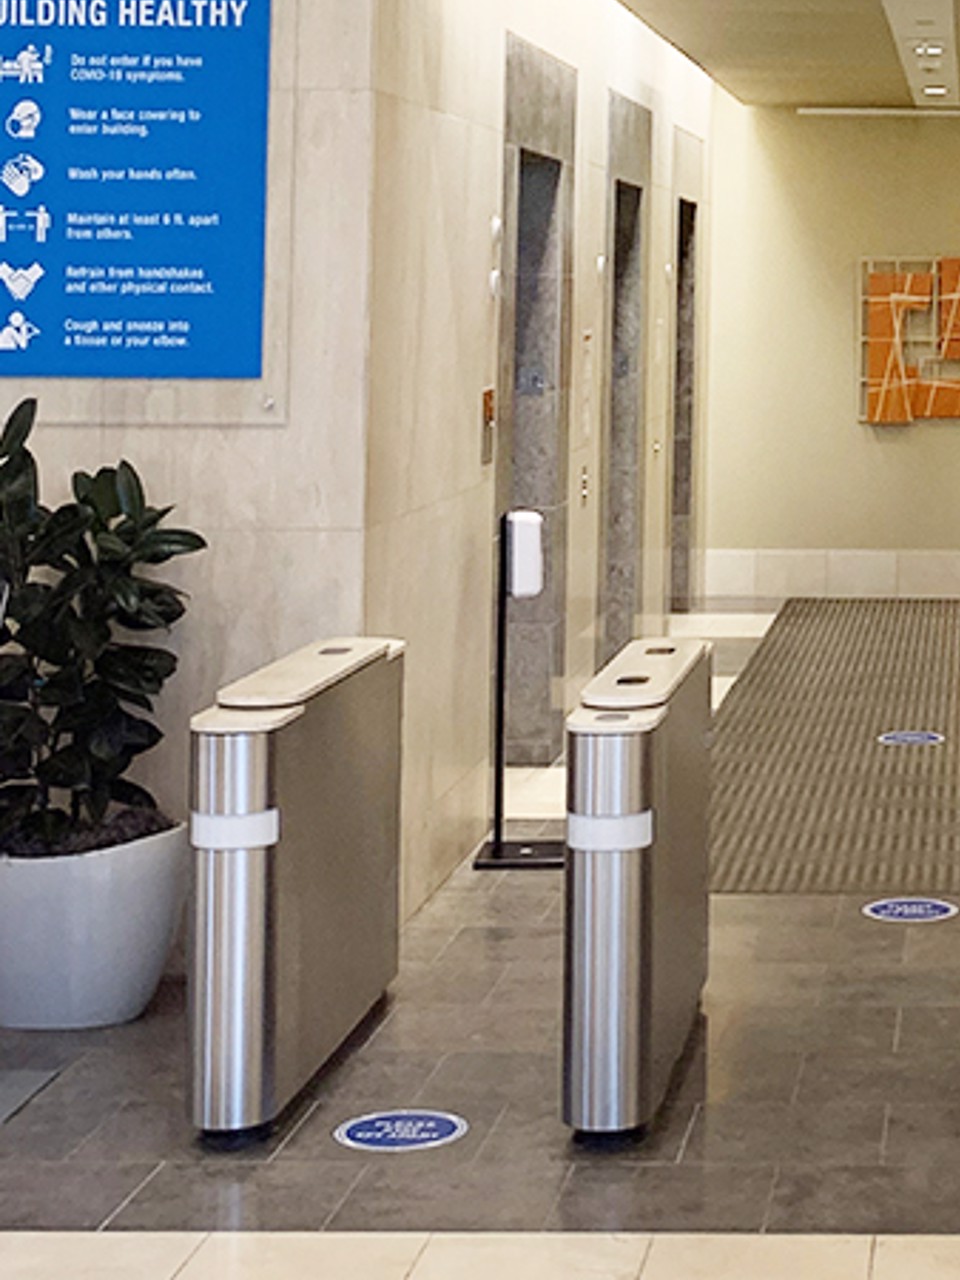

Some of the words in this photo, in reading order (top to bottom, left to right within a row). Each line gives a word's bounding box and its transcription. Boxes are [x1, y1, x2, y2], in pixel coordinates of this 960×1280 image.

[118, 0, 248, 27] HEALTHY
[70, 54, 86, 66] Do
[88, 55, 107, 67] not
[109, 55, 140, 67] enter
[142, 54, 152, 67] if
[153, 57, 174, 69] you
[176, 55, 203, 67] have
[125, 70, 185, 84] symptoms.
[68, 108, 98, 120] Wear
[101, 111, 109, 120] a
[110, 108, 135, 121] face
[138, 109, 186, 124] covering
[187, 110, 201, 121] to
[68, 124, 98, 135] enter
[68, 168, 98, 180] Wash
[101, 170, 126, 182] your
[128, 168, 162, 180] hands
[164, 168, 197, 181] often.
[66, 212, 116, 225] Maintain
[118, 214, 130, 225] at
[132, 213, 160, 225] least
[188, 214, 219, 228] apart
[66, 227, 93, 239] from
[96, 227, 133, 240] others.
[65, 266, 106, 279] Refrain
[107, 267, 135, 278] from
[137, 267, 204, 280] handshakes
[65, 281, 87, 293] and
[88, 281, 118, 294] other
[119, 281, 167, 296] physical
[169, 281, 214, 294] contact.
[64, 319, 99, 334] Cough
[102, 319, 123, 332] and
[125, 322, 165, 332] sneeze
[167, 320, 190, 332] into
[73, 334, 108, 346] tissue
[109, 336, 123, 346] or
[124, 336, 151, 348] your
